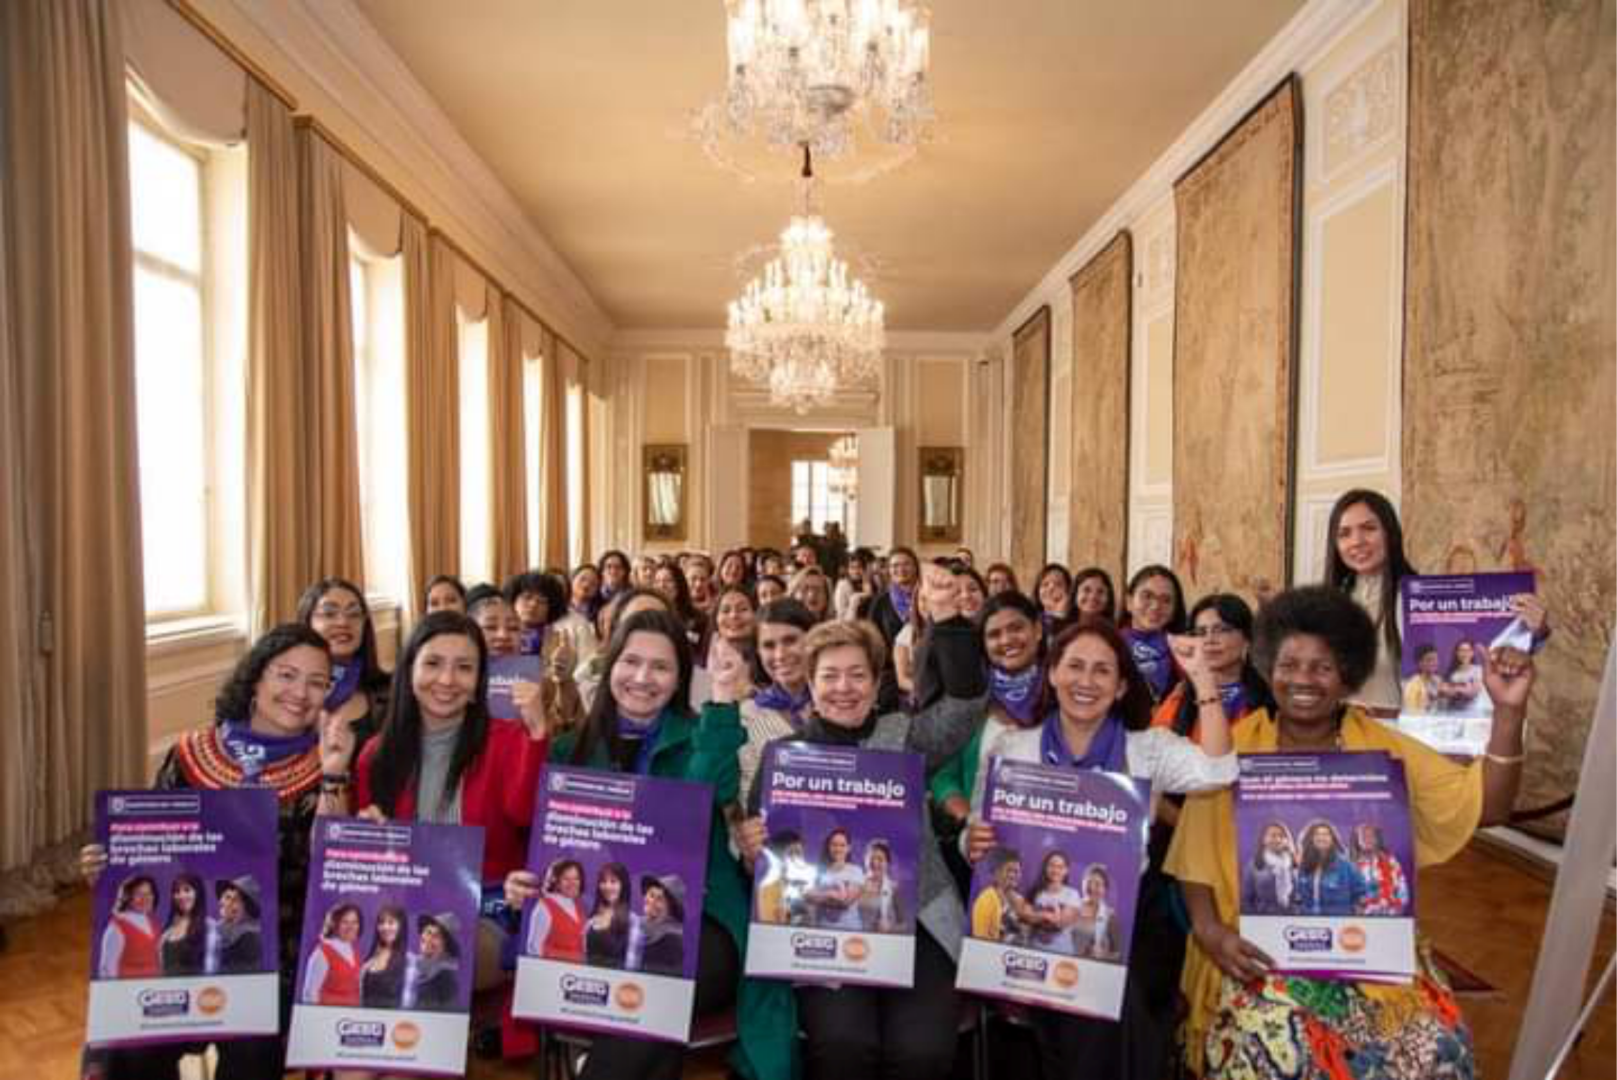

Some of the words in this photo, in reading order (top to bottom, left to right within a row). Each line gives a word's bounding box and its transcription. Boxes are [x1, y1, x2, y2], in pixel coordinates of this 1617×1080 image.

[1409, 598, 1435, 612] Por
[1437, 599, 1458, 611] un
[772, 772, 806, 789] Por
[808, 777, 833, 791] un
[837, 778, 905, 799] trabajo
[993, 789, 1026, 805] Por
[1029, 796, 1054, 812] un
[1058, 798, 1128, 824] trabajo
